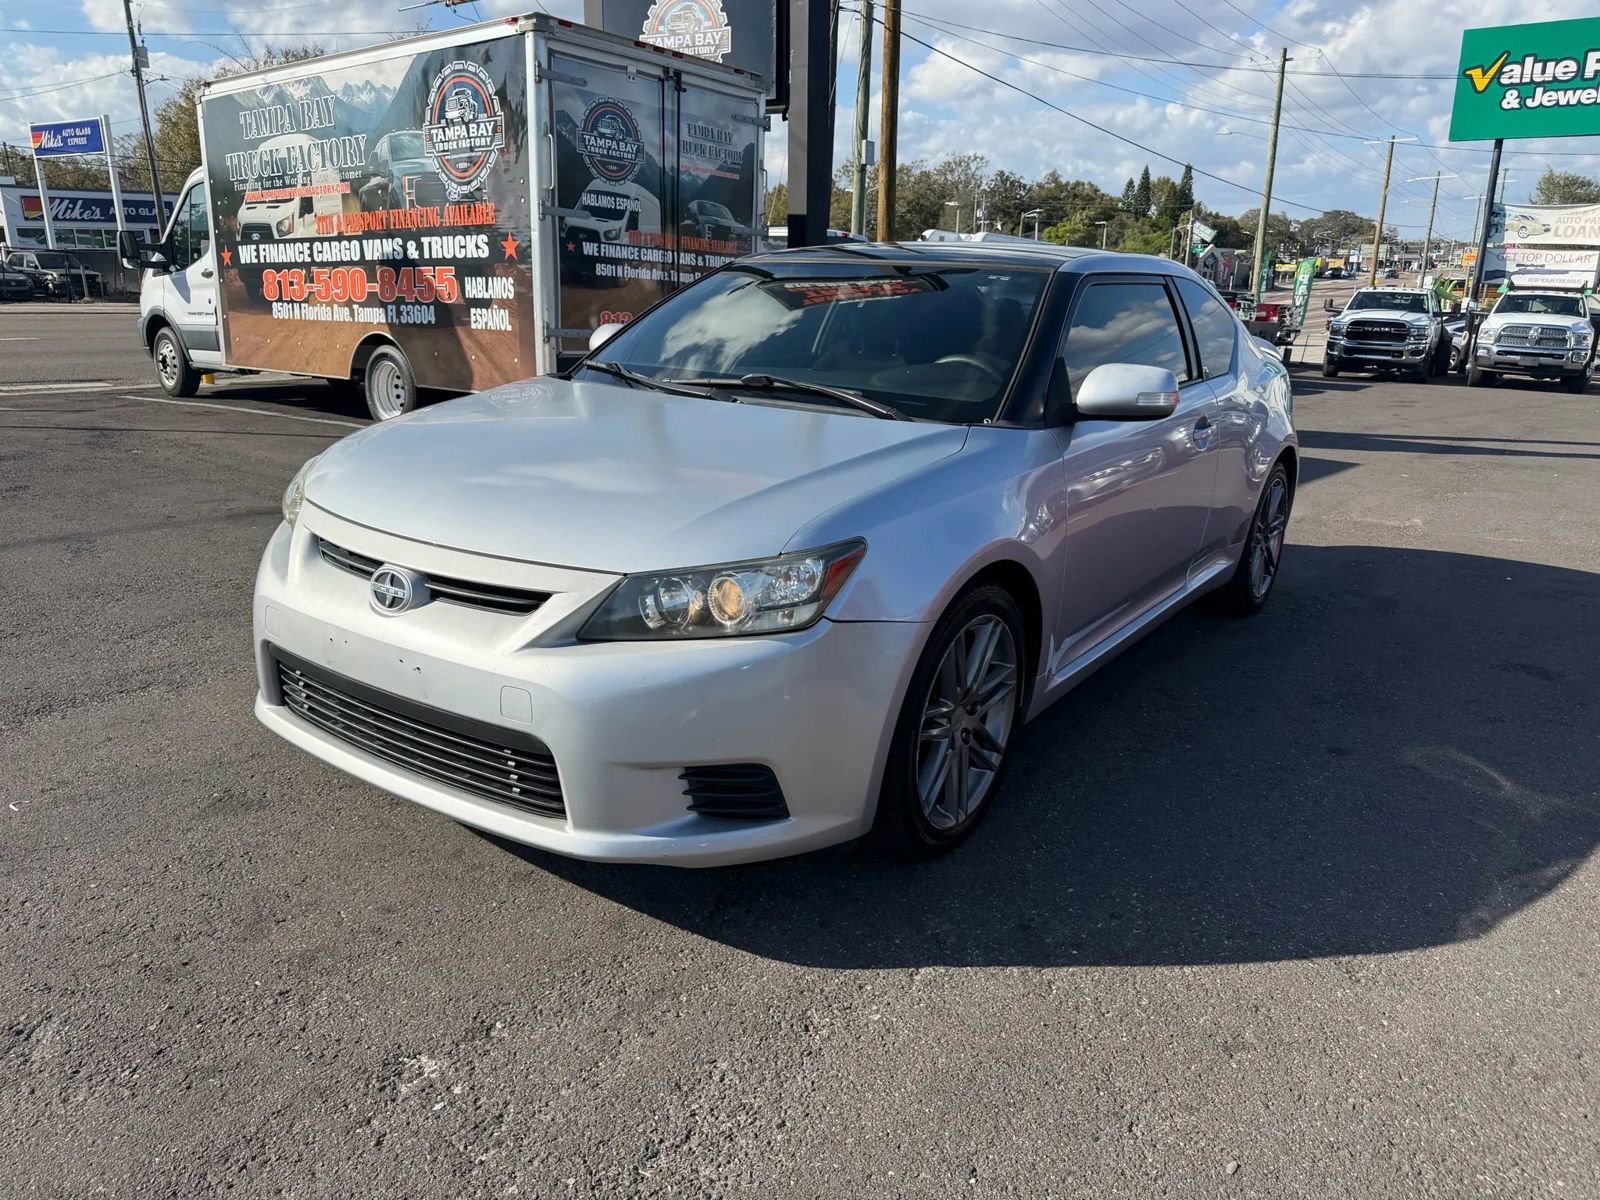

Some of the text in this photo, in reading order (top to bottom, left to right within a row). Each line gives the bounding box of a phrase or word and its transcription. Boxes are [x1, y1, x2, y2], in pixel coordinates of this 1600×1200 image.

[695, 31, 723, 46] BAY
[1501, 88, 1521, 109] &
[239, 95, 336, 140] TAMPA BAY
[40, 127, 92, 149] Mike's AUTO GLASS
[67, 136, 88, 146] EXPRESS
[430, 121, 495, 142] TAMPA BAY
[434, 136, 492, 152] TRUCK FACTORY
[583, 134, 638, 154] TAMPA BAY
[586, 145, 636, 160] TRUCK FACTORY
[679, 139, 708, 158] RUCK
[225, 133, 367, 181] TRUCK FACTORY
[262, 178, 272, 189] for
[273, 177, 284, 187] the
[49, 198, 170, 220] Mike's ATO GLAS
[582, 191, 616, 210] HABLAMOS
[343, 210, 389, 233] PASSPORT
[389, 206, 440, 230] FINANCING
[443, 202, 496, 227] AVAILABLE
[1555, 216, 1582, 225] AUTO
[238, 234, 490, 264] WE FINANCE CARGO VANS & TRUCKS
[582, 241, 600, 257] WE
[600, 243, 640, 260] FINANCE
[640, 247, 673, 265] CARGO
[697, 255, 704, 267] &
[1496, 252, 1592, 265] GET TOP DOLLAR
[595, 262, 616, 277] 8501
[616, 265, 623, 278] N
[623, 265, 651, 280] Florida
[262, 266, 458, 303] 813-590-8455
[464, 276, 515, 299] HABLAMOS
[272, 302, 293, 320] 8501
[293, 302, 300, 320] N
[301, 302, 332, 321] Florida
[332, 303, 353, 322] Ave.
[353, 304, 386, 325] Tampa
[400, 304, 436, 325] 33604
[470, 303, 513, 331] ESPAÑOL
